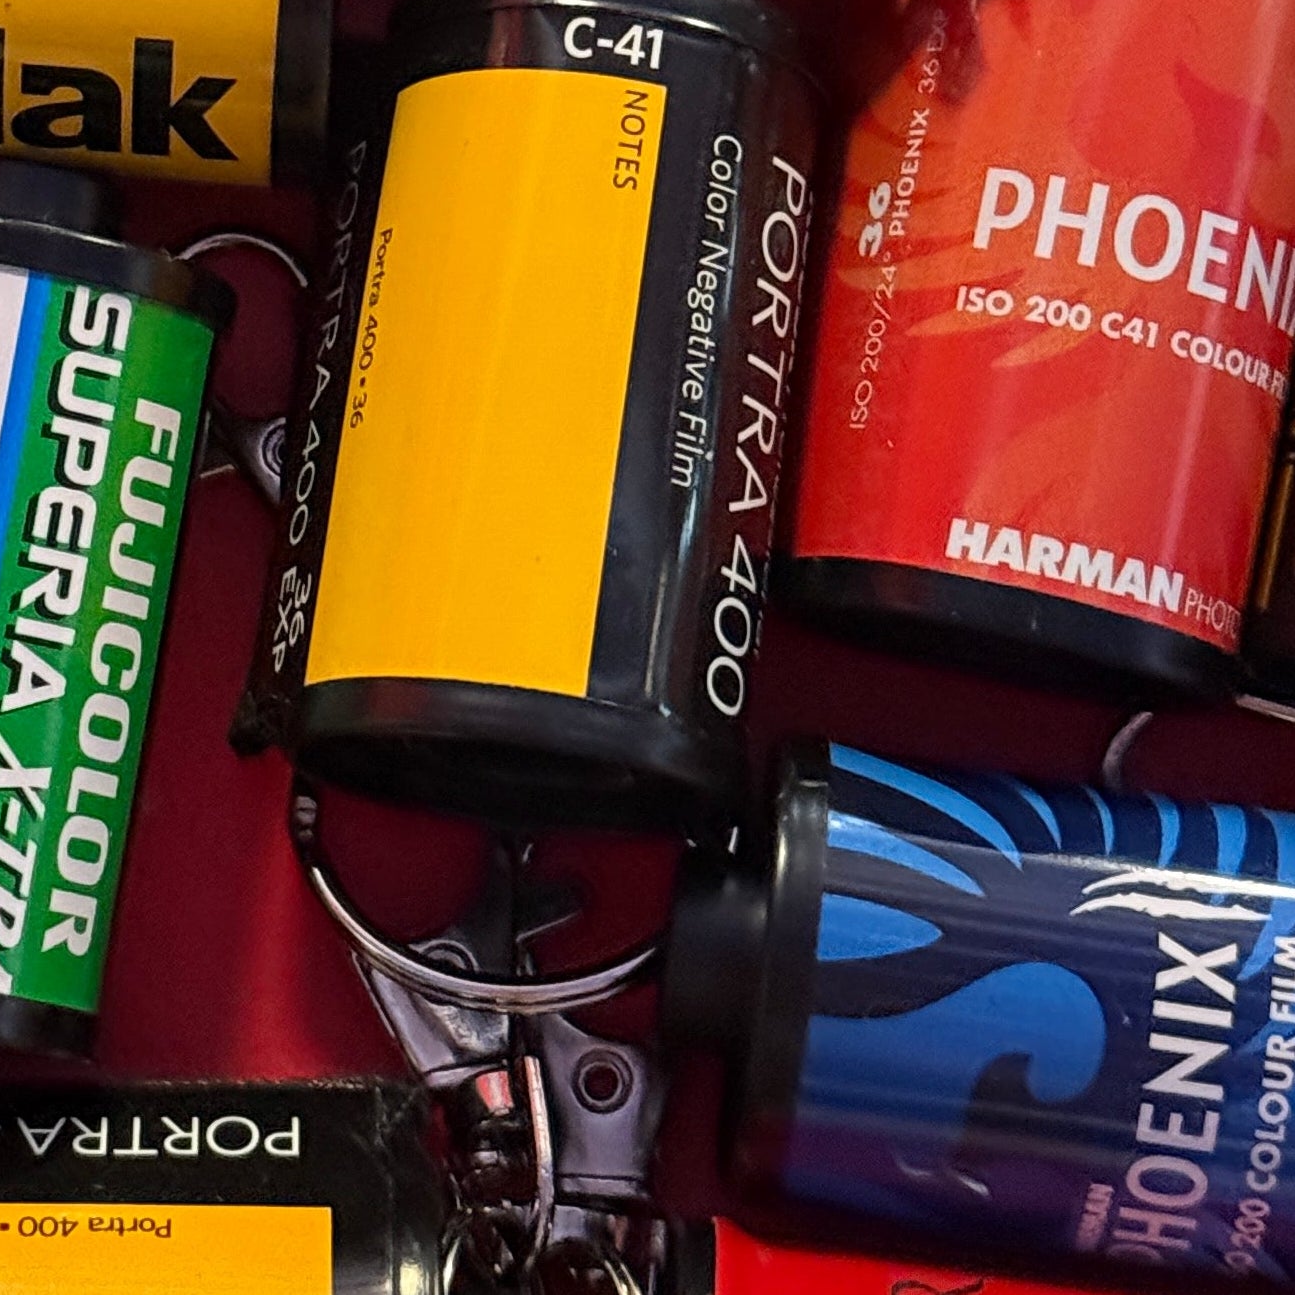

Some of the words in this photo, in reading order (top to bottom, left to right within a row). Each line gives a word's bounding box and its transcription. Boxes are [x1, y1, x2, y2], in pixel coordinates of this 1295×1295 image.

[562, 15, 665, 72] C-41
[612, 88, 650, 193] NOTES
[703, 132, 743, 253] Color
[367, 226, 394, 309] Portra
[848, 380, 874, 431] ISO
[888, 107, 931, 239] PHOENIX
[917, 58, 940, 95] 36
[858, 180, 891, 259] 36
[972, 166, 1295, 338] PHOENI
[309, 140, 367, 411] PORTRA
[679, 245, 731, 402] Negative
[358, 314, 379, 372] 400
[727, 153, 808, 516] PORTRA
[956, 285, 1014, 317] ISO
[1024, 294, 1092, 333] 200
[1100, 312, 1161, 350] C41
[1170, 329, 1270, 391] COLOUR
[349, 394, 369, 430] 36
[668, 409, 717, 490] Film
[289, 419, 320, 547] 400
[288, 572, 313, 648] 36
[945, 516, 1184, 614] HARMAN
[271, 565, 298, 674] EXP
[704, 533, 760, 717] 400
[40, 397, 182, 958] FUJICOLOR
[16, 1114, 302, 1160] PORTRA
[1106, 931, 1239, 1258] HOENIX
[1246, 1034, 1295, 1194] COLOUR
[16, 1214, 80, 1238] 400
[86, 1215, 174, 1238] Portra
